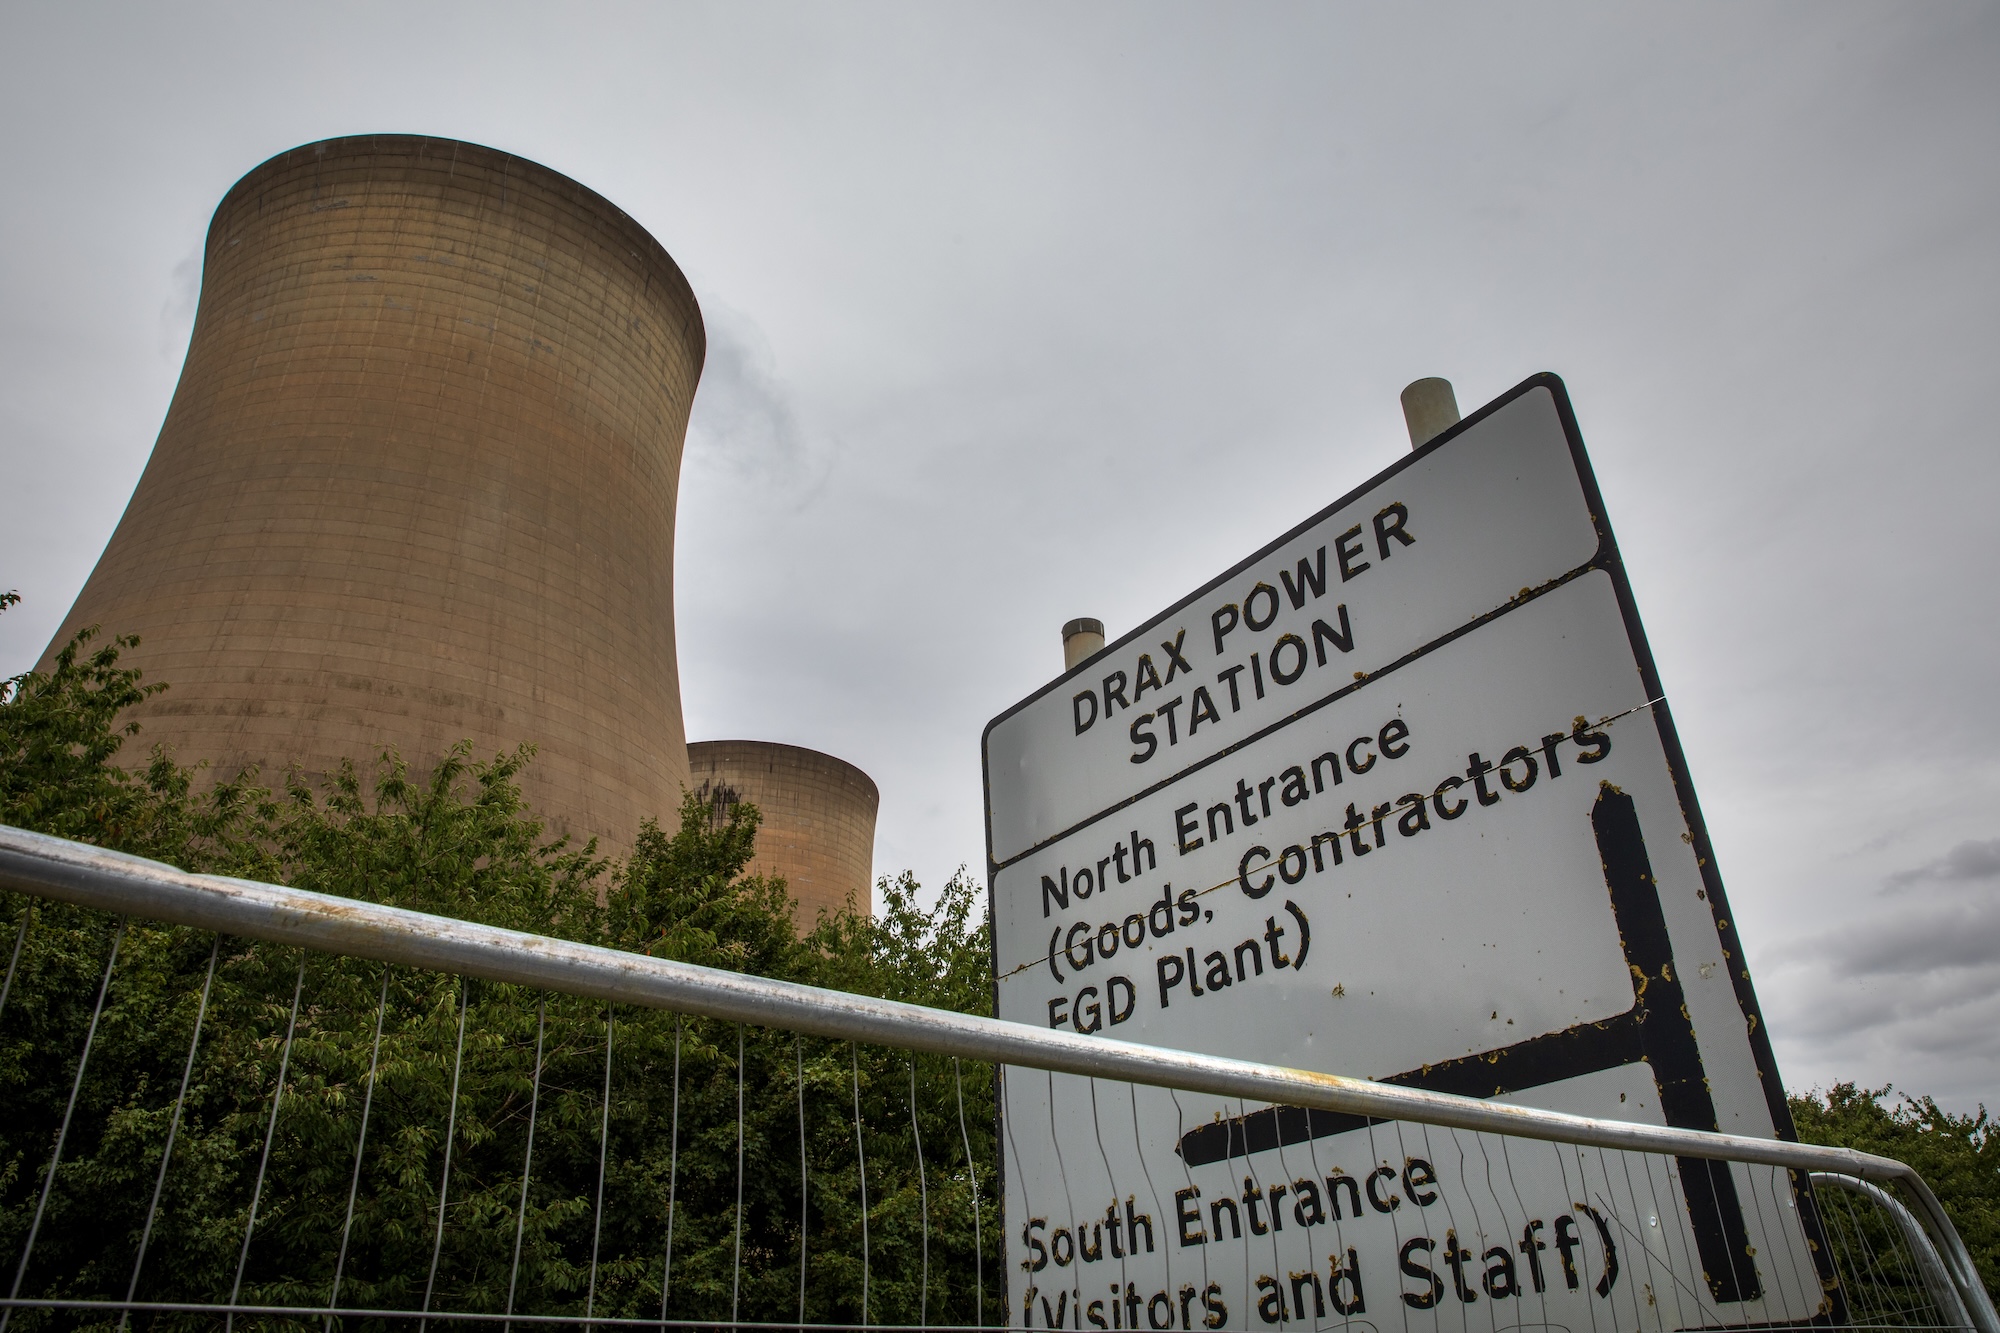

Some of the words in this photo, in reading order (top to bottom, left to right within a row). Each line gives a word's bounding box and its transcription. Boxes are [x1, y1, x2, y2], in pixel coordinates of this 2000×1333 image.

[1072, 628, 1193, 736] DRAX
[1213, 502, 1416, 655] POWER
[1129, 603, 1355, 765] STATION
[1041, 830, 1156, 918] North
[1173, 718, 1411, 857] Entrance
[1048, 883, 1214, 984] (Goods,
[1238, 715, 1612, 900] Contractors
[1158, 900, 1310, 1009] Plant)
[1022, 1198, 1155, 1273] South
[1176, 1158, 1438, 1248] Entrance
[1256, 1248, 1366, 1325] and
[1400, 1203, 1620, 1310] Staff)
